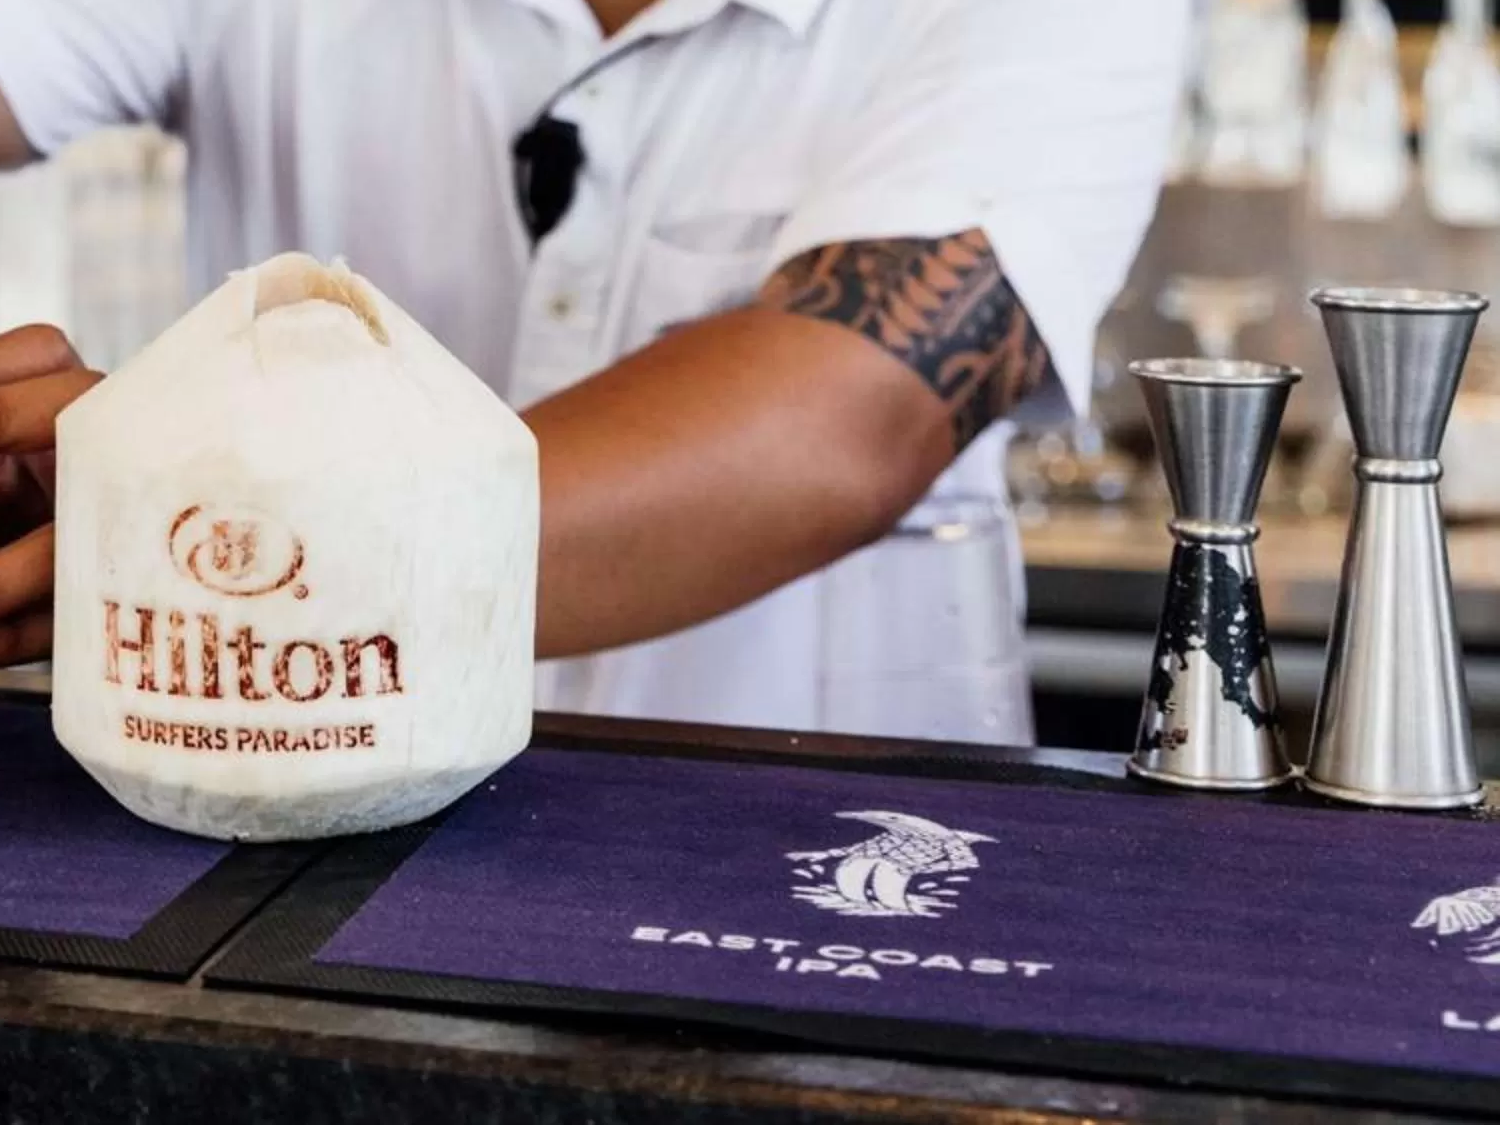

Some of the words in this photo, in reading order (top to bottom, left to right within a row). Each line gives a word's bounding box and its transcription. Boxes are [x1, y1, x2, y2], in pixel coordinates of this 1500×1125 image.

[103, 600, 403, 703] Hilton
[124, 715, 229, 751] SURFERS
[237, 724, 376, 753] PARADISE
[630, 926, 801, 954] EAST
[817, 944, 1054, 977] COAST
[776, 956, 881, 980] IPA
